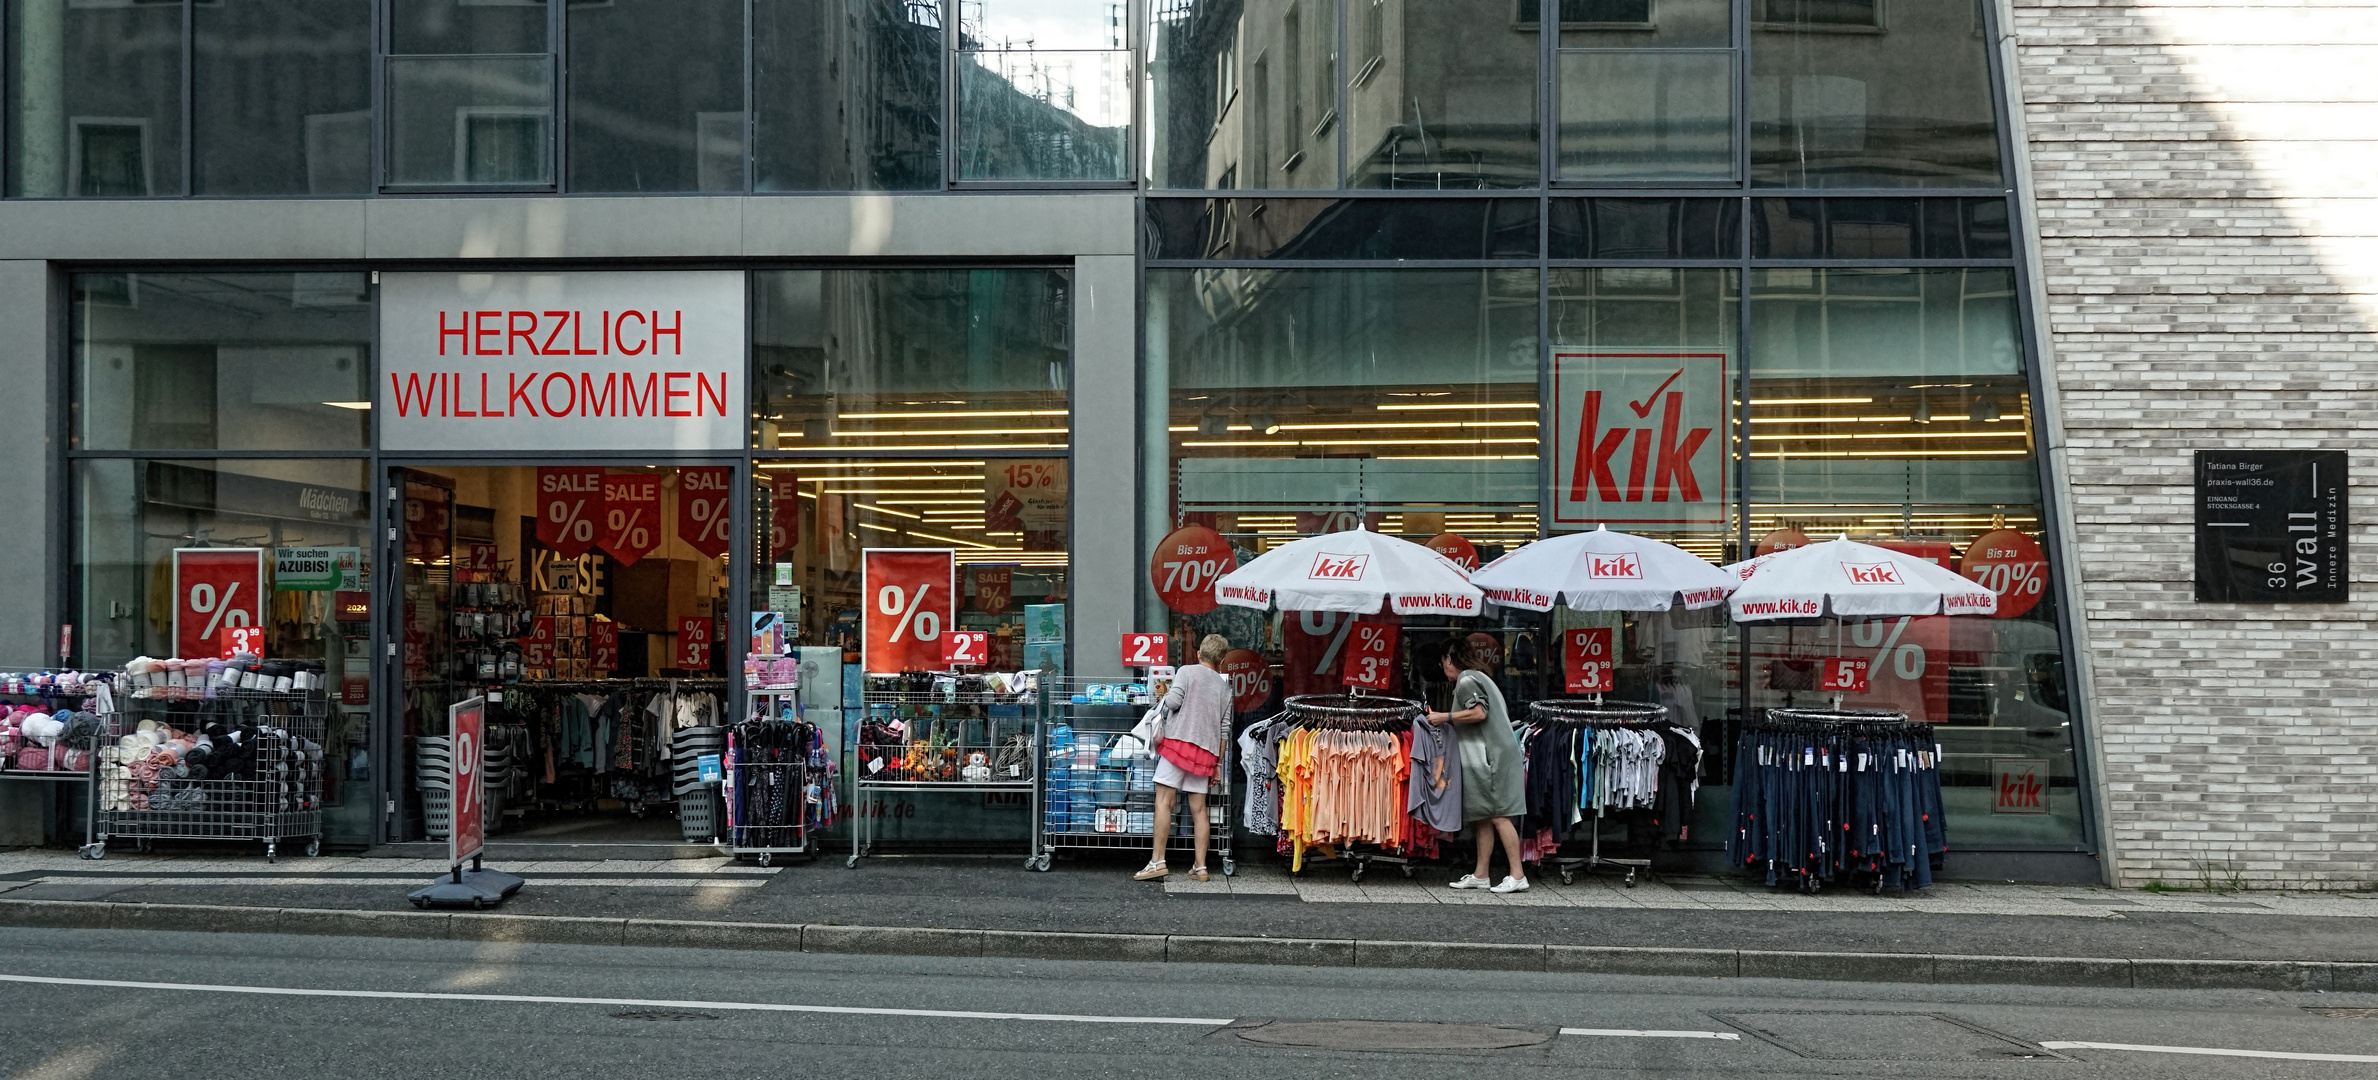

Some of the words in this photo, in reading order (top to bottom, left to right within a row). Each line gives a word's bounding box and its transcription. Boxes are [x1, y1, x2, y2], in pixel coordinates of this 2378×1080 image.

[439, 310, 681, 356] HERZLICH
[391, 372, 727, 418] WILLKOMMEN
[1569, 368, 1713, 502] kik
[2206, 462, 2237, 470] Tatiana
[2239, 462, 2263, 471] Birger
[542, 473, 600, 492] SALE
[684, 472, 728, 491] SAL
[1004, 465, 1054, 488] 15%
[2207, 478, 2274, 487] praxis-wall36.de
[299, 487, 349, 513] Mädchen
[604, 484, 655, 501] SALE
[2326, 487, 2337, 538] Medizin
[278, 549, 295, 558] Wir
[296, 549, 329, 559] suchen
[1177, 544, 1193, 555] Bis
[1195, 545, 1208, 555] zu
[1436, 546, 1447, 554] Bis
[1449, 546, 1458, 554] zu
[1774, 542, 1786, 550] Bis
[1986, 548, 2001, 559] Bis
[2003, 548, 2018, 558] zu
[2287, 511, 2317, 590] wall
[278, 560, 329, 573] AZUBIS!
[338, 556, 354, 569] kik
[1314, 556, 1361, 577] kik
[1593, 555, 1636, 577] kik
[2327, 546, 2337, 589] Innere
[978, 573, 1008, 583] SALE
[1162, 557, 1229, 593] 70%
[1851, 564, 1896, 582] kik
[1972, 561, 2041, 596] 70%
[2267, 562, 2287, 588] 36
[1222, 586, 1268, 604] www.kik.de
[1399, 592, 1473, 610] www.kik.de
[1946, 592, 1992, 609] www.kik.de
[346, 604, 367, 612] 2024
[1742, 598, 1817, 615] www.kik.de
[1227, 662, 1239, 671] Bis
[1381, 677, 1387, 685] €
[1999, 765, 2046, 808] kik
